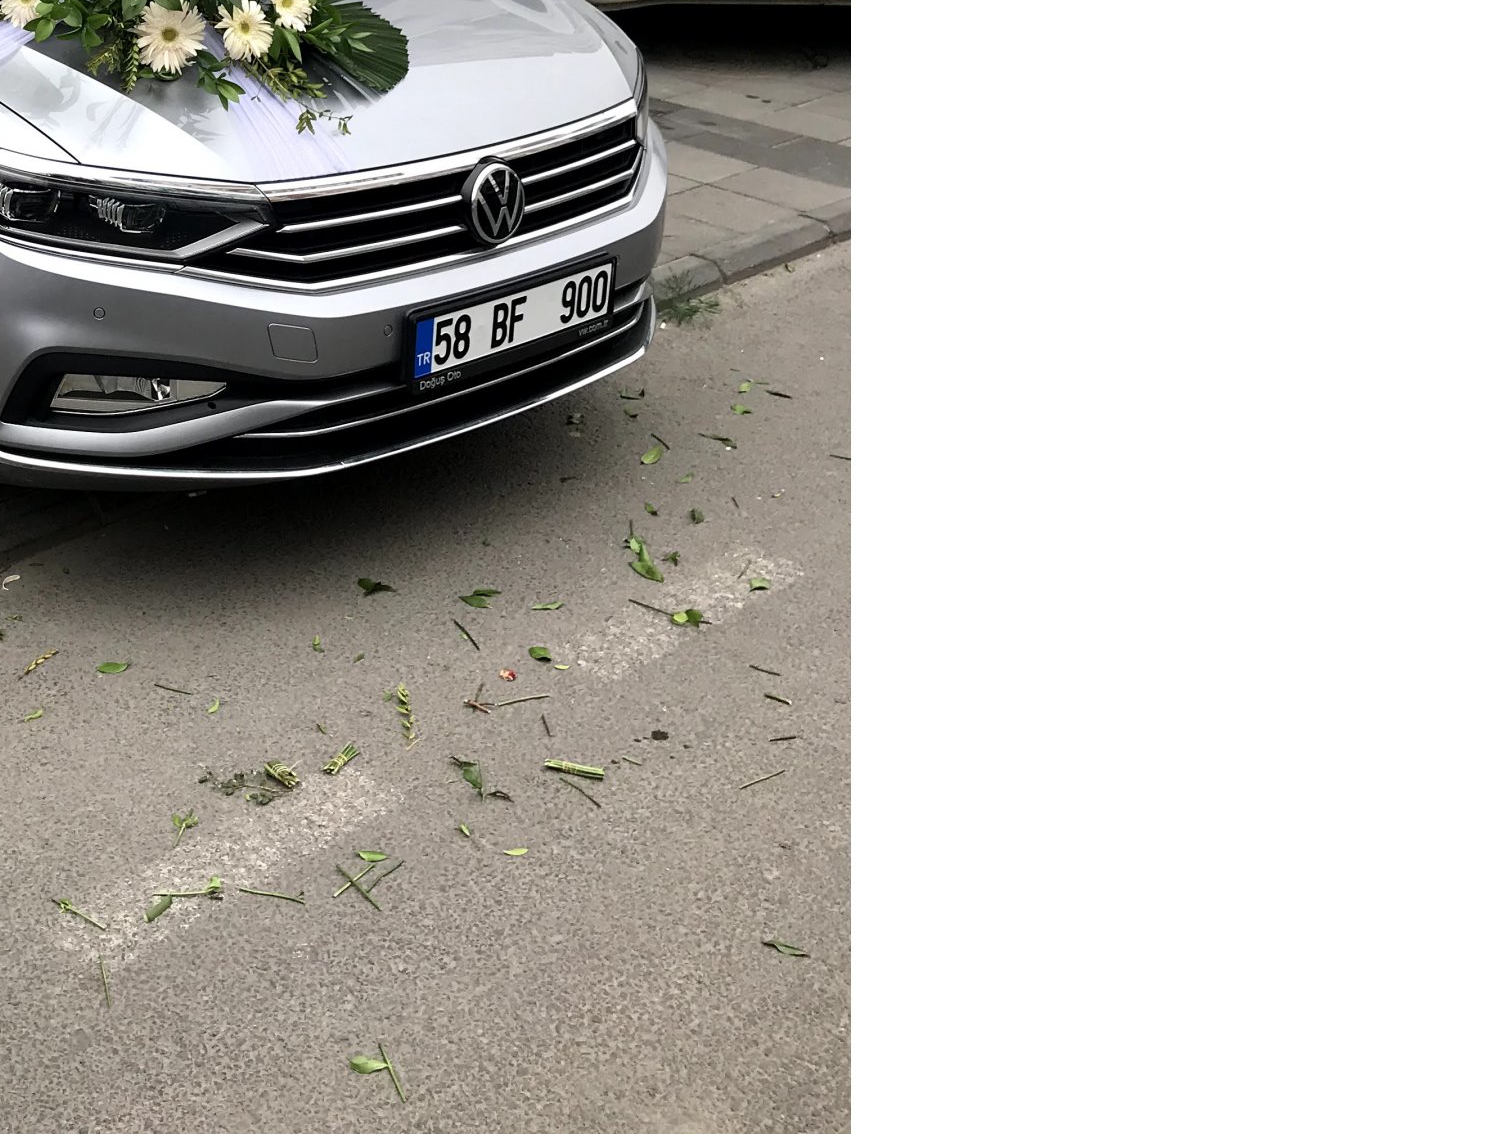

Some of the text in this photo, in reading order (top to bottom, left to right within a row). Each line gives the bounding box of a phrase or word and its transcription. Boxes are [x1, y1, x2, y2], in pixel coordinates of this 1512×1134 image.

[434, 269, 609, 366] 58 BF 900
[416, 351, 431, 367] TR
[419, 370, 462, 391] Doğuş Oto
